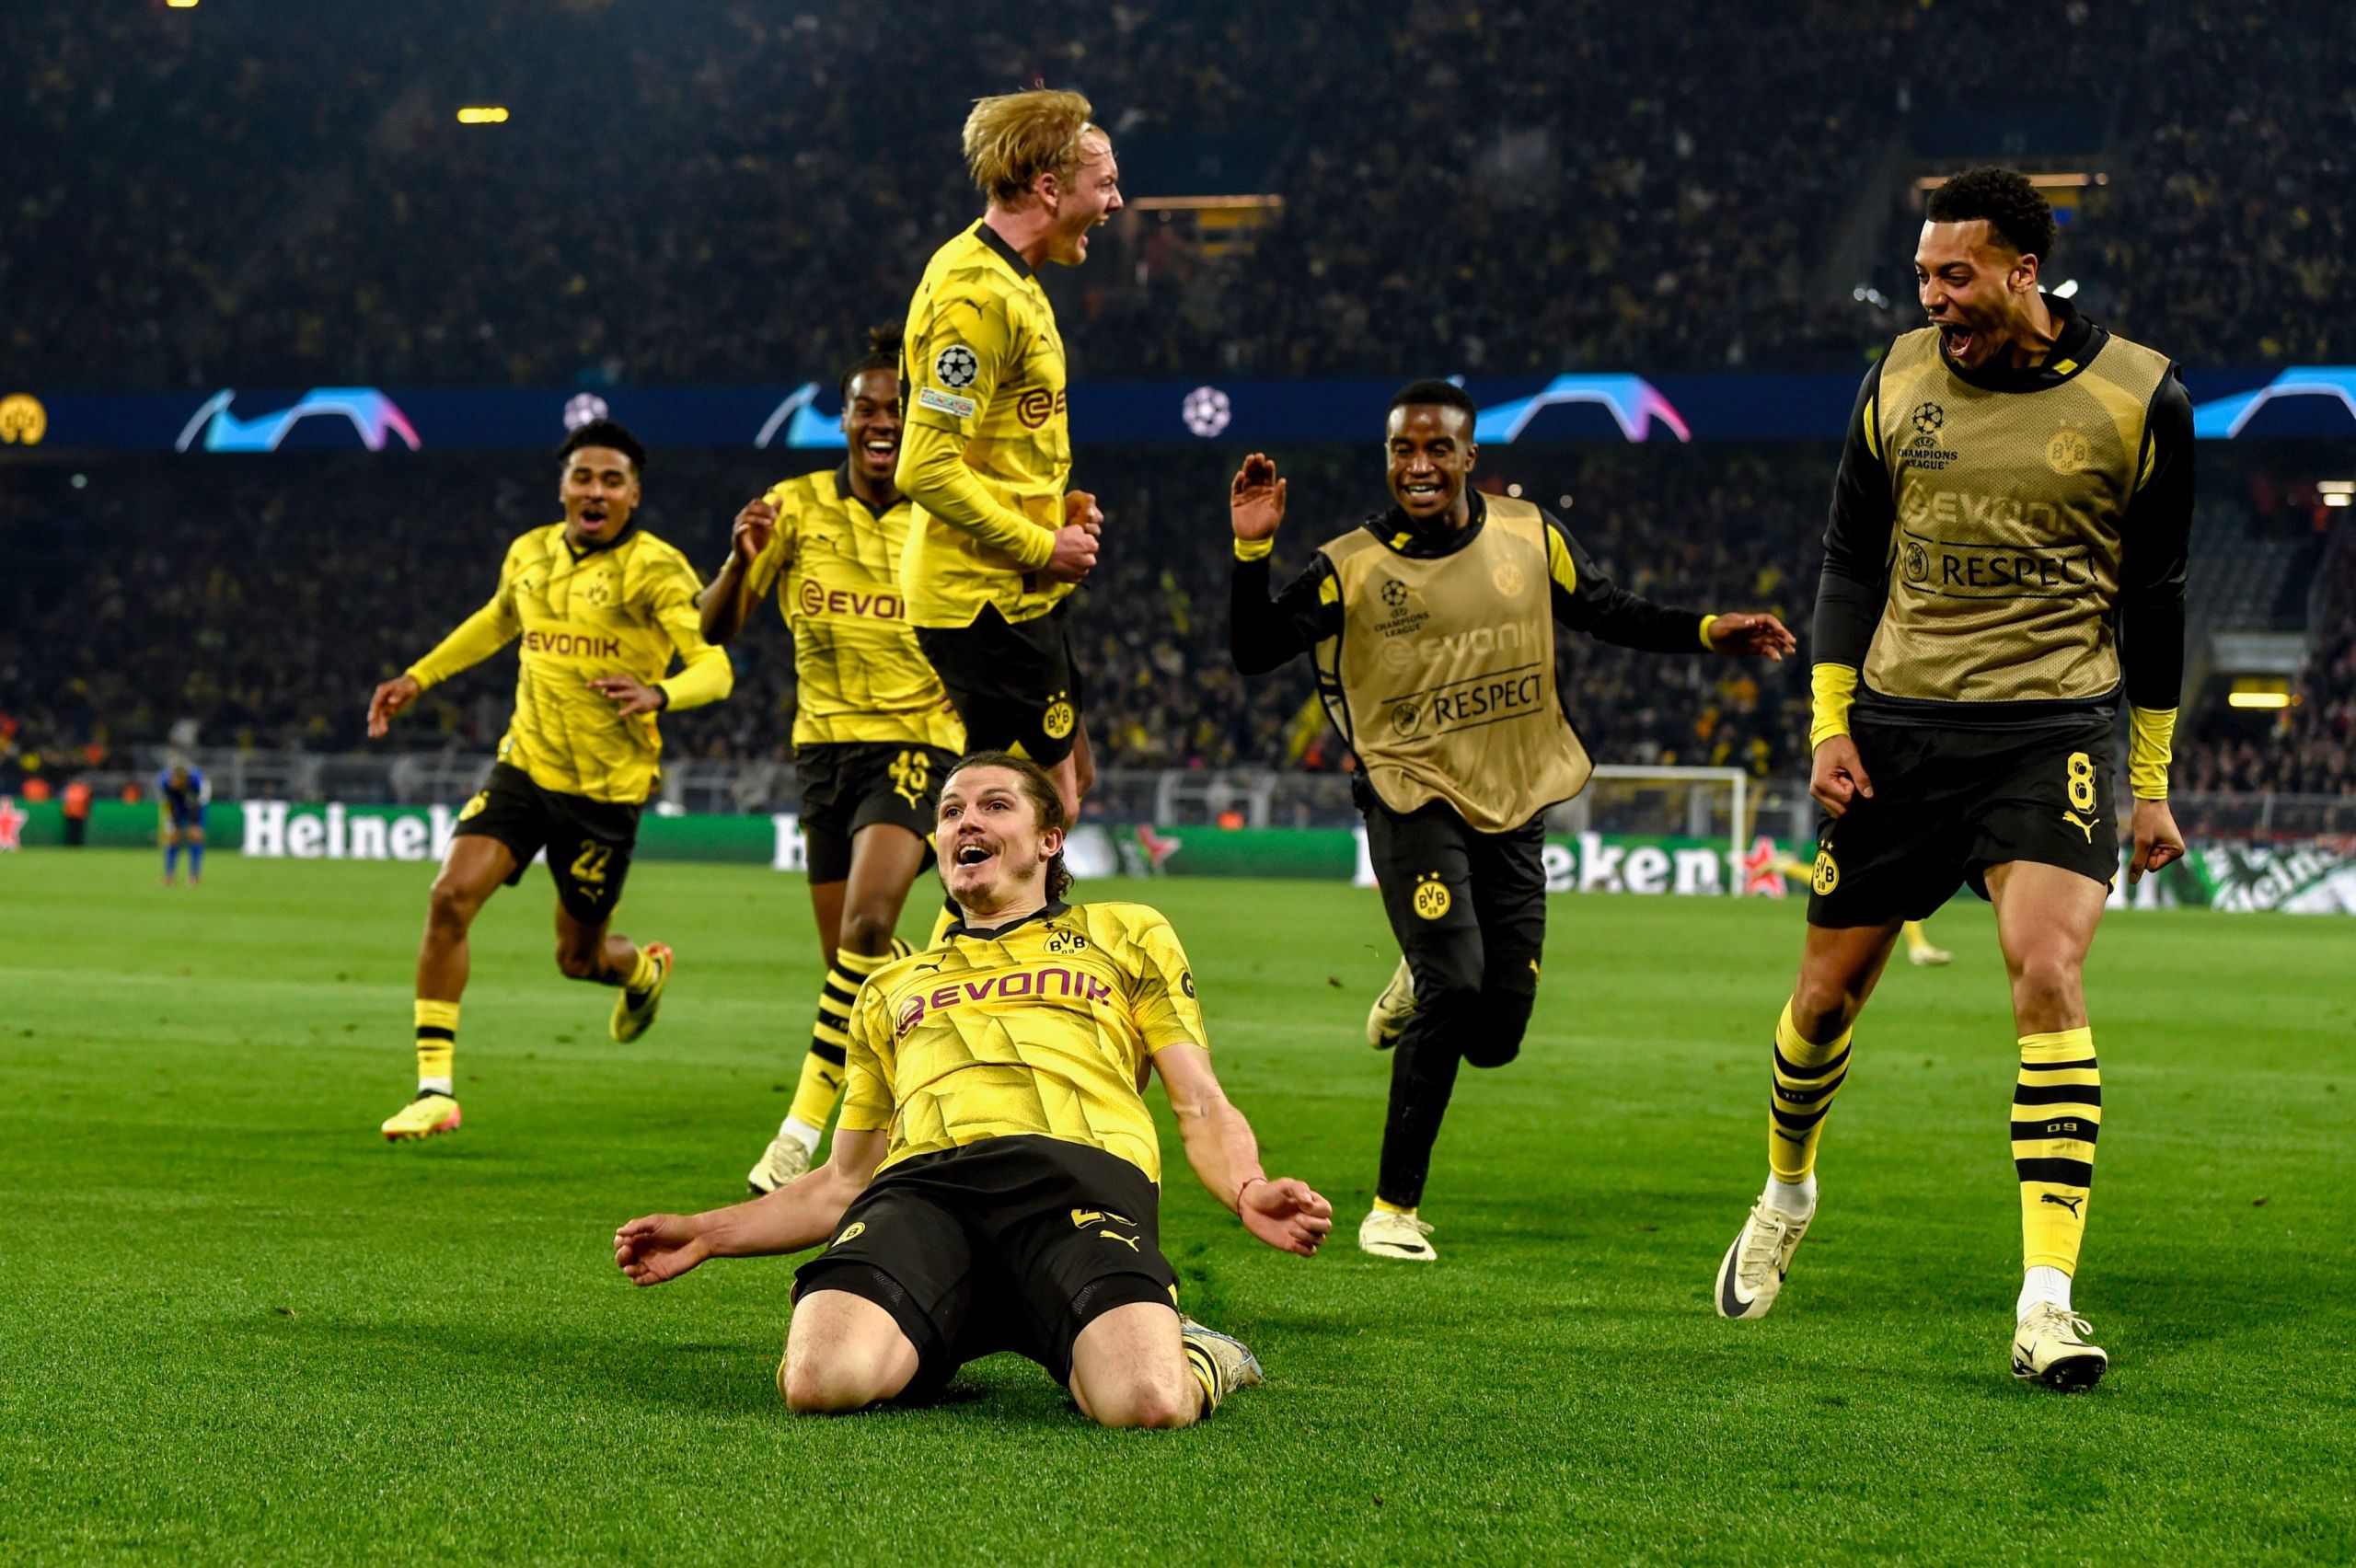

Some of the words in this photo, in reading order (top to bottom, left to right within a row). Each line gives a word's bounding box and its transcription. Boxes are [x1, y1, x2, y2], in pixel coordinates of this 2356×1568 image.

[1898, 449, 1958, 460] CHAMPIONS
[1943, 554, 2099, 587] RESPECT
[829, 590, 905, 619] EVO
[1374, 611, 1429, 632] CHAMPIONS
[527, 631, 619, 657] EVONIK
[1434, 674, 1542, 724] RESPECT
[1048, 704, 1069, 729] BVB
[2068, 752, 2096, 814] 8
[570, 839, 613, 882] 22
[1816, 854, 1835, 882] BVB
[1418, 885, 1446, 909] BVB
[1050, 929, 1086, 951] BVB
[931, 968, 1112, 1009] EVONIK
[2047, 1123, 2077, 1132] 09
